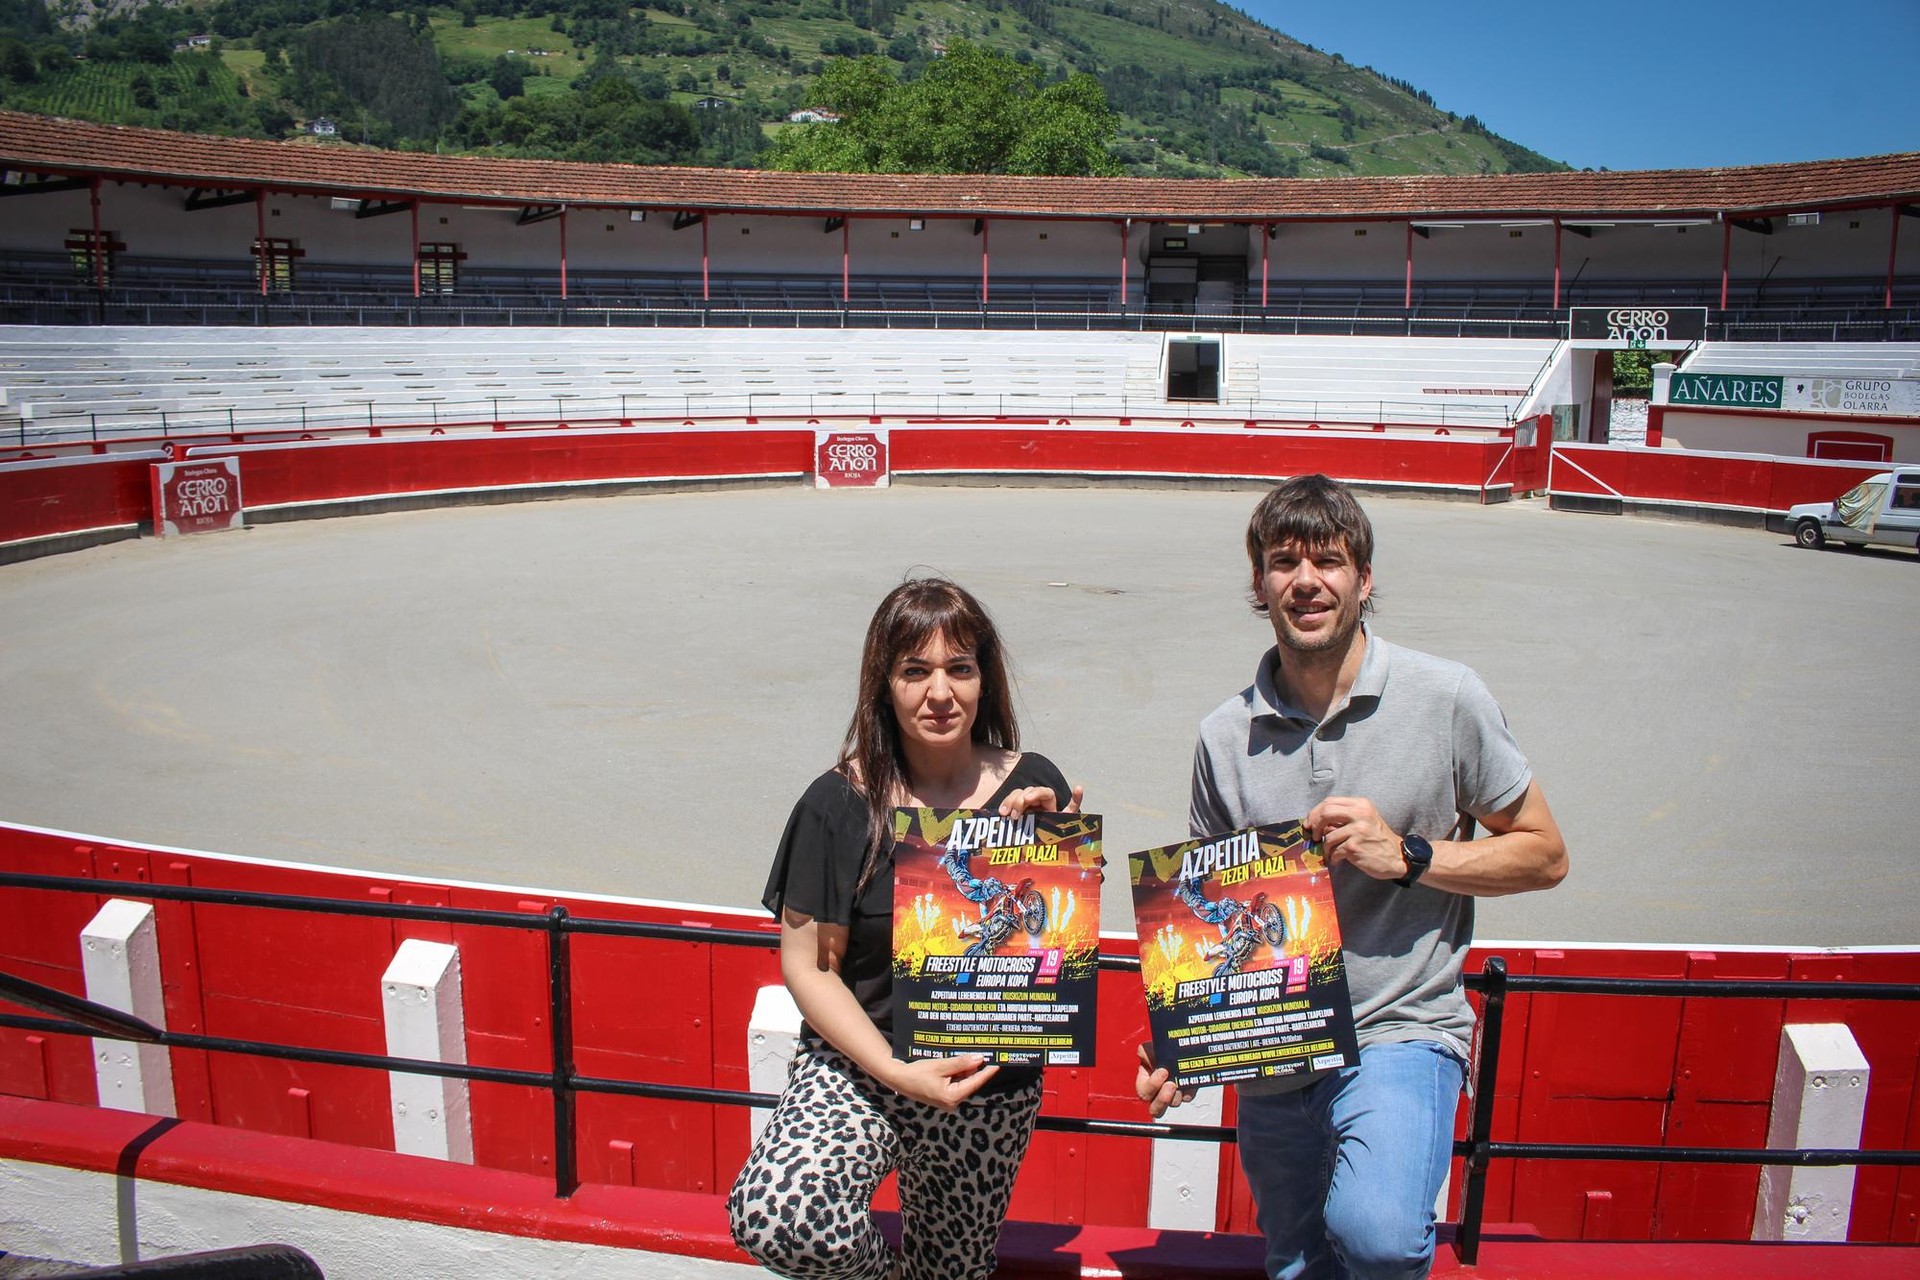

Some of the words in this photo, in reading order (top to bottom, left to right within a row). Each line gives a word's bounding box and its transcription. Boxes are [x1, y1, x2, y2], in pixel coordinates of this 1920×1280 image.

[1607, 310, 1669, 326] CERRO
[1673, 376, 1778, 403] AÑARES
[1845, 381, 1891, 392] GRUPO
[1844, 392, 1890, 401] BODEGAS
[1843, 401, 1889, 411] OLARRA
[828, 444, 877, 458] CERRO
[177, 477, 227, 499] CERRO
[989, 848, 1021, 866] ZEZEN
[1025, 844, 1058, 863] PLAZA
[1179, 830, 1261, 882] AZPEITIA
[1220, 864, 1250, 887] ZEZEN
[1254, 855, 1286, 878] PLAZA
[926, 957, 977, 972] FREESTYLE
[976, 958, 1036, 973] MOTOCROSS
[1046, 950, 1059, 967] 19
[1293, 957, 1304, 976] 19
[975, 975, 1006, 987] EUROPA
[1007, 975, 1029, 987] KOPA
[1178, 976, 1227, 999] FREESTYLE
[1227, 968, 1284, 991] MOTOCROSS
[1228, 991, 1258, 1006] EUROPA
[1258, 985, 1280, 1001] KOPA
